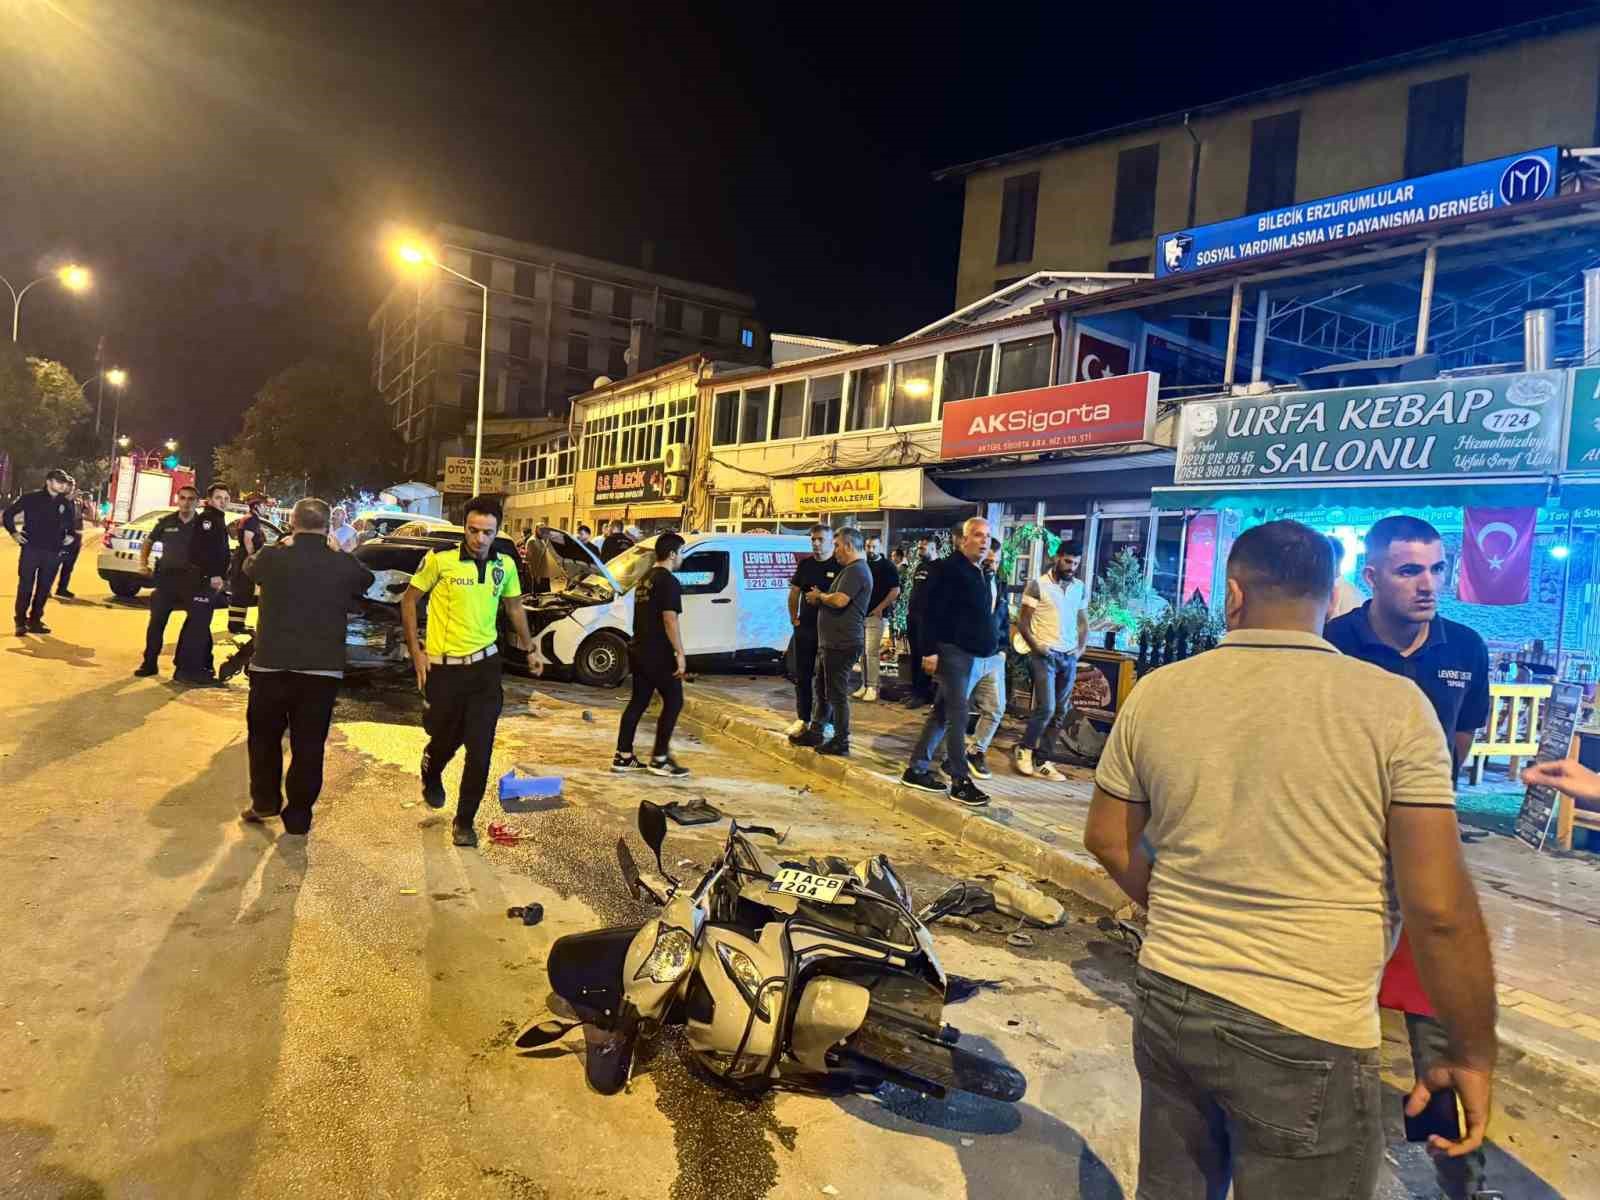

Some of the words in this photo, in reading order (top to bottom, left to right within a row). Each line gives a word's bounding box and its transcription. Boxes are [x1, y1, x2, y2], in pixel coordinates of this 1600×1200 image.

[1258, 209, 1303, 232] BİLECİK
[1306, 185, 1415, 221] ERZURUMLULAR
[1196, 245, 1236, 266] SOSYAL
[1327, 223, 1344, 240] VE
[1428, 188, 1494, 221] DERNEĞİ
[967, 403, 1110, 436] AKSigorta
[1226, 402, 1326, 438] URFA
[1338, 388, 1494, 432] KEBAP
[1492, 413, 1530, 429] 7/24
[1259, 435, 1437, 474] SALONU
[802, 478, 871, 495] TUNALI
[785, 881, 818, 896] 204
